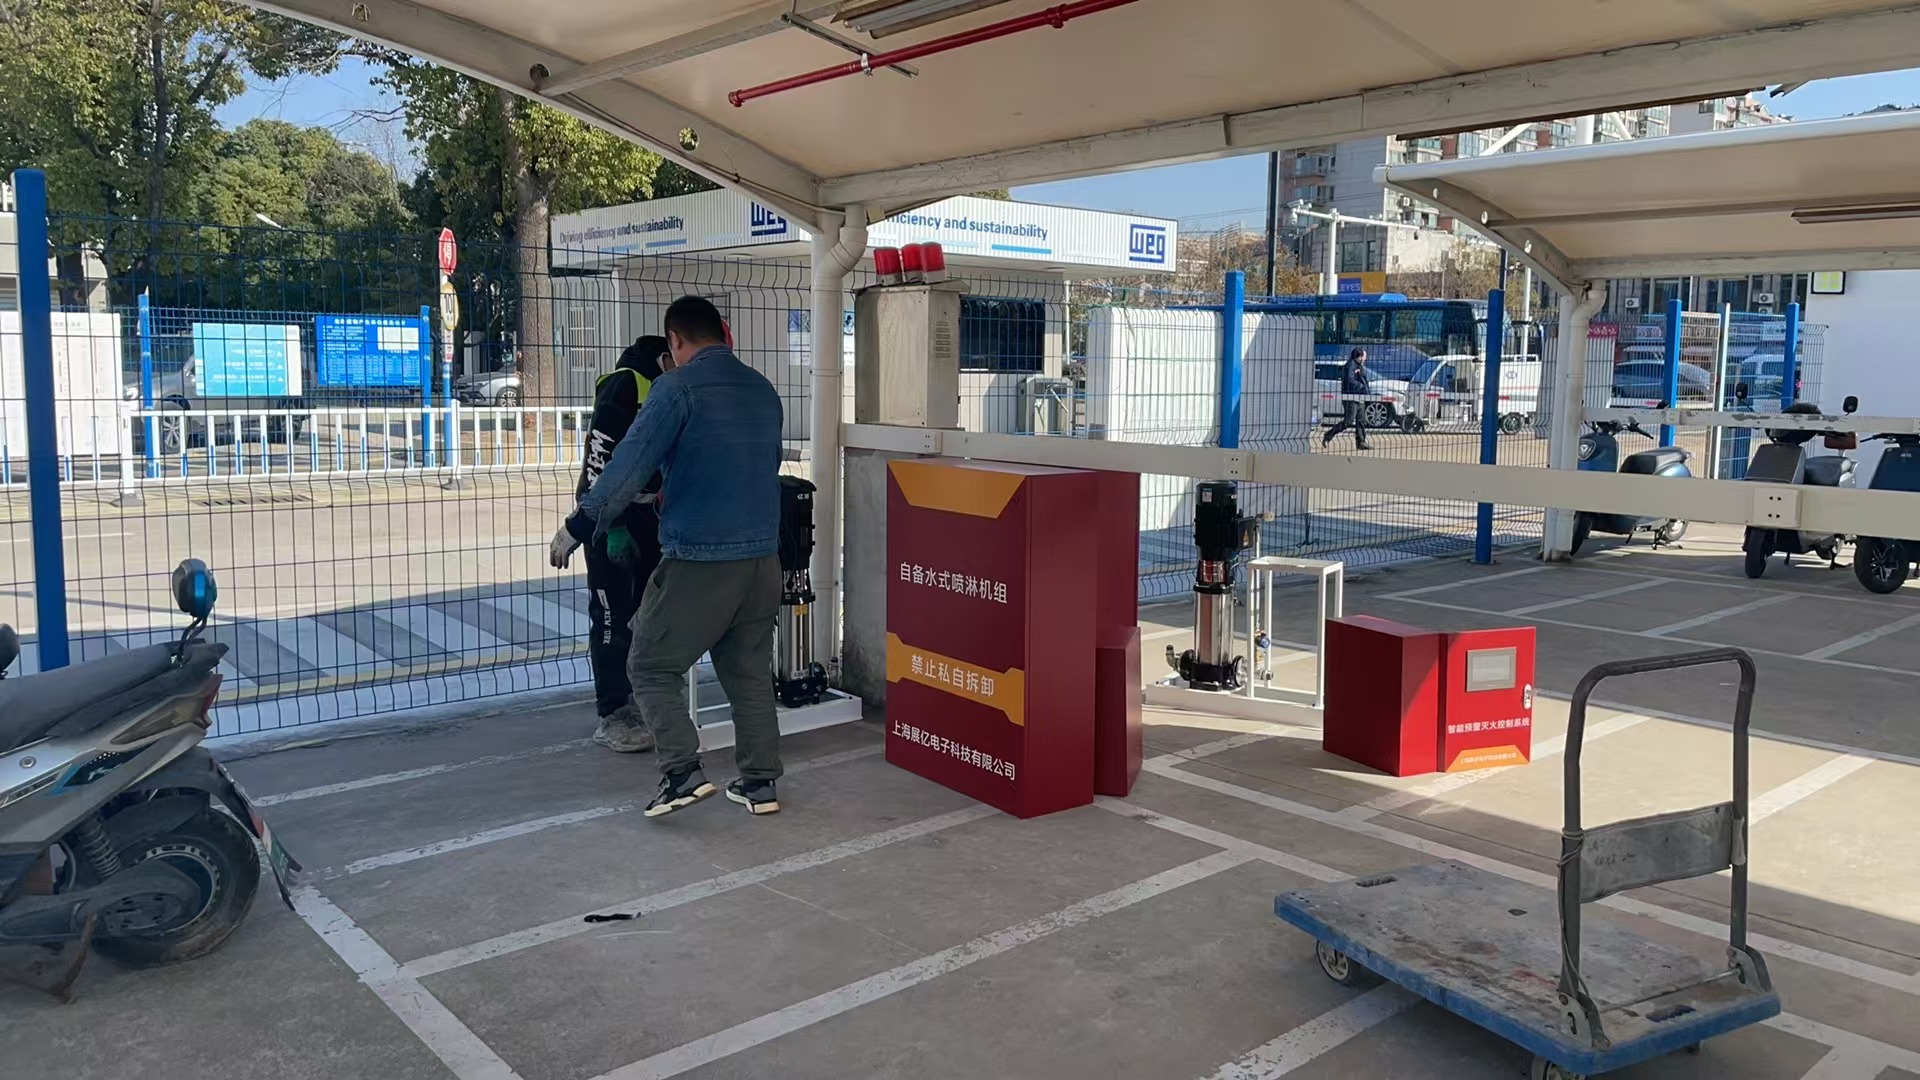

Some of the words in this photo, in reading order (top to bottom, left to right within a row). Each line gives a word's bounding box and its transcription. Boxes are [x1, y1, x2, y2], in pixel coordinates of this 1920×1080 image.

[560, 229, 584, 244] Driving
[584, 226, 616, 240] efficiency
[617, 222, 631, 235] and
[632, 216, 685, 233] sustainability
[944, 217, 967, 230] and
[969, 220, 1049, 241] sustainability
[900, 562, 1007, 603] 自备水式喷淋机组
[911, 653, 995, 697] 禁止私自拆卸
[1448, 717, 1529, 734] 智能预警灭火控制系统
[892, 720, 1016, 781] 上海展亿电子科技有限公司
